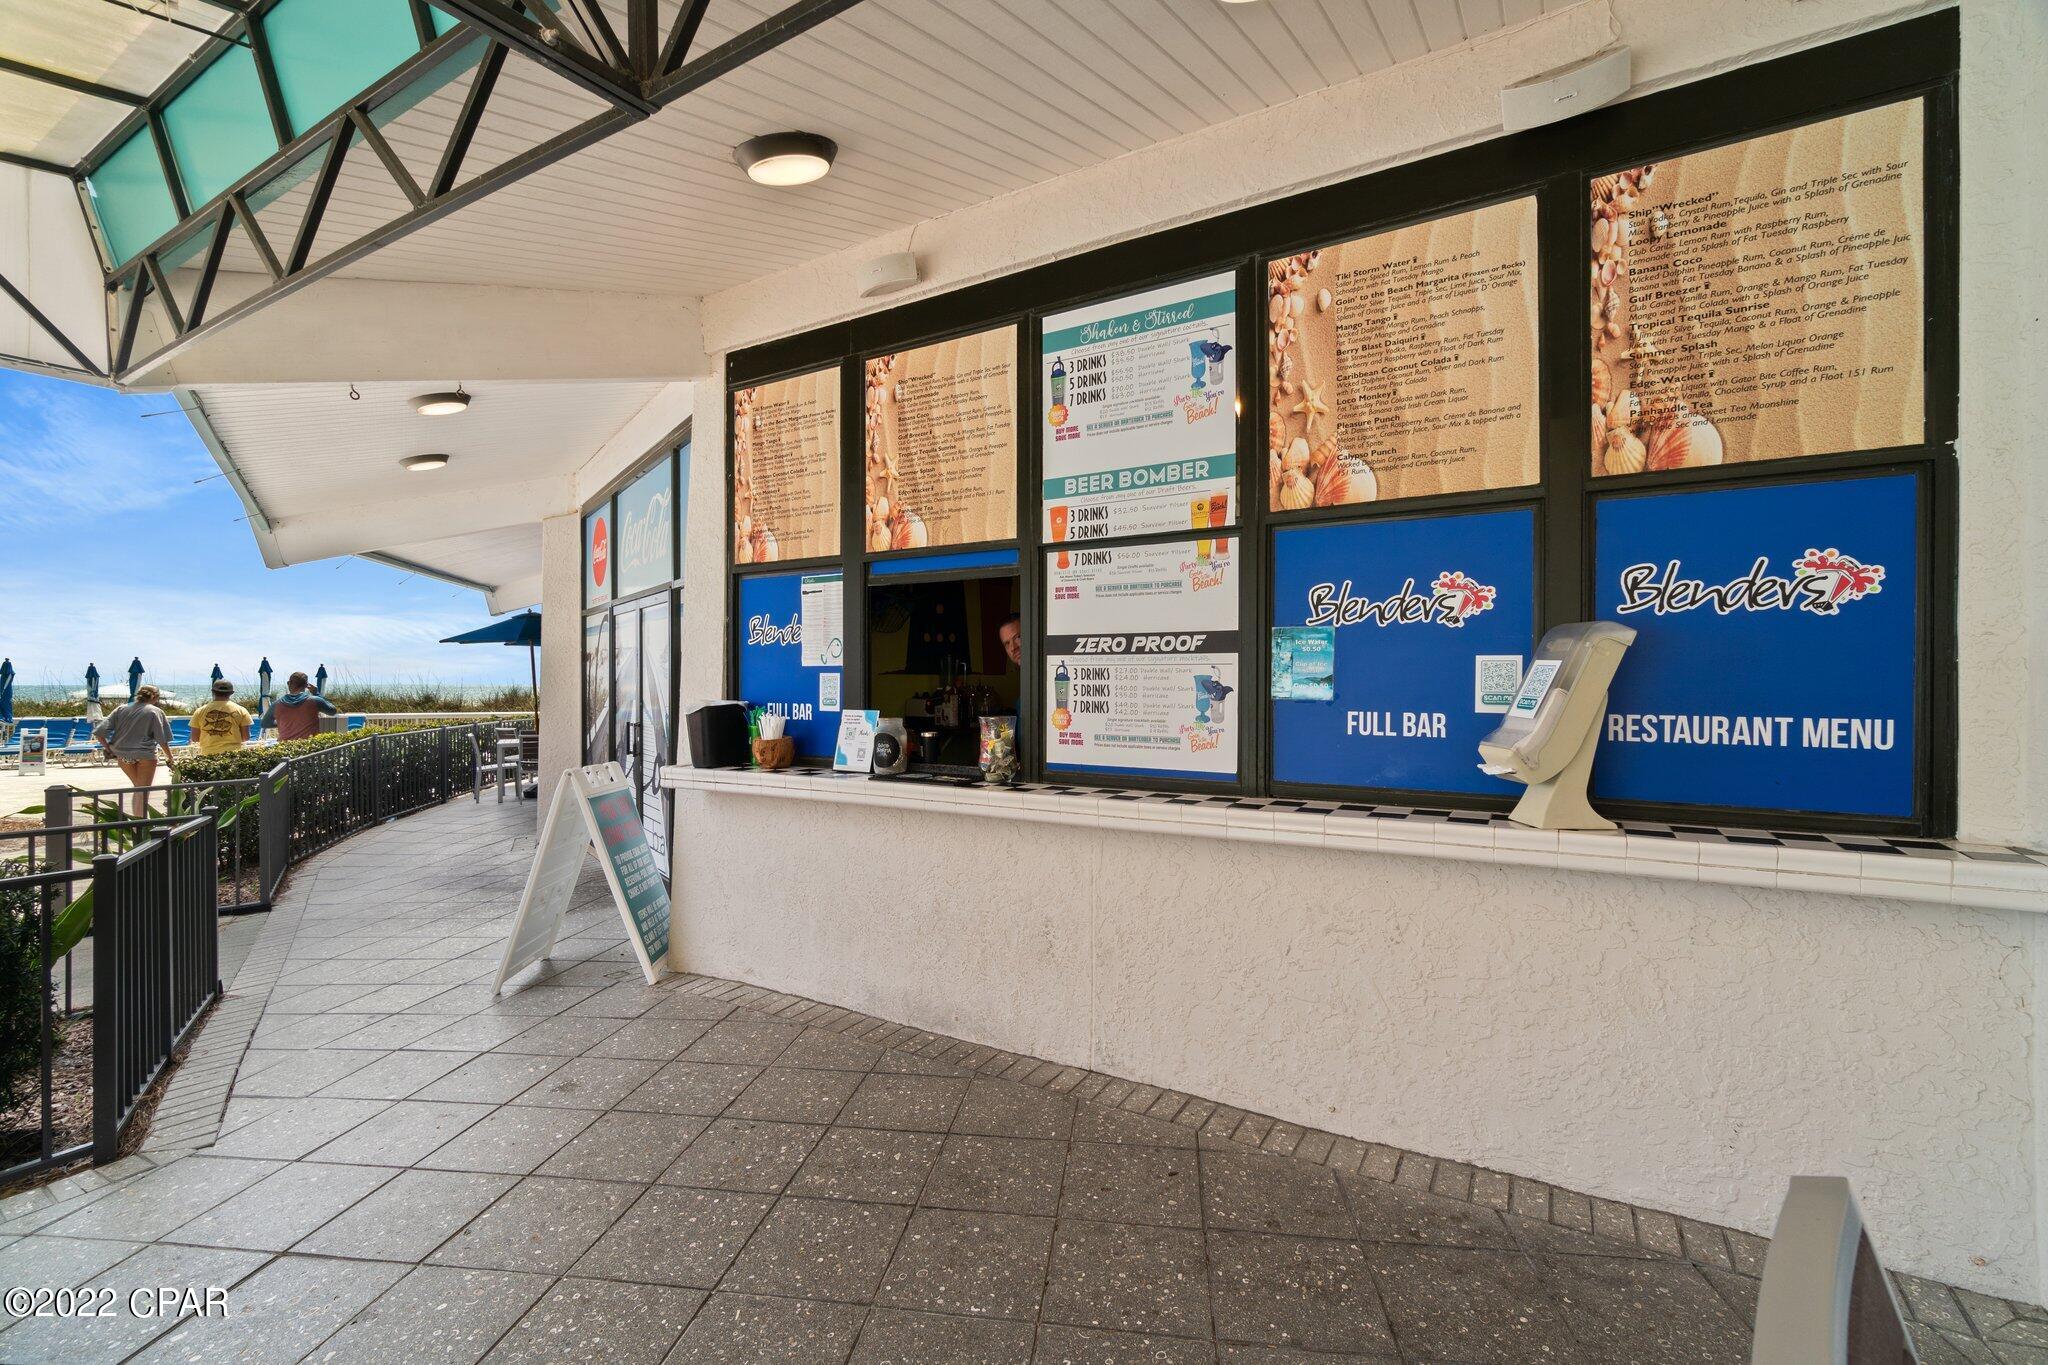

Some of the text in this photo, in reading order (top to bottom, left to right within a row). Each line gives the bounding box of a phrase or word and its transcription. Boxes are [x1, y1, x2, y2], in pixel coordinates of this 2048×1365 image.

[1679, 204, 1708, 218] Crystal
[1771, 187, 1785, 196] Gin
[1789, 182, 1806, 192] and
[1811, 175, 1837, 189] Triple
[1841, 171, 1857, 181] Sec
[1861, 166, 1881, 176] with
[1886, 160, 1908, 171] Sour
[1628, 220, 1726, 247] Loopy Lemonade
[1335, 258, 1410, 280] Tiki Storm Water
[1629, 255, 1702, 275] Banana Coco
[1371, 290, 1384, 298] the
[1387, 284, 1413, 294] Beach
[1416, 274, 1458, 290] Margarita
[1629, 284, 1701, 303] Gulf Breezer
[1629, 310, 1656, 322] Mango
[1660, 307, 1675, 315] and
[1699, 297, 1728, 308] Colada
[1732, 293, 1749, 302] with
[1763, 286, 1791, 298] Splash
[1795, 284, 1805, 293] of
[1808, 277, 1842, 290] Orange
[1845, 272, 1868, 284] Juice
[1080, 303, 1194, 343] Shaken & Stirred
[1336, 315, 1390, 332] Mango Tango
[1629, 301, 1769, 332] Tropical Tequila Sunrise
[1336, 334, 1418, 357] Berry Blast Daiquiri
[1629, 340, 1717, 359] Summer Splash
[1070, 355, 1106, 374] 3 DRINKS
[1336, 356, 1451, 381] Caribbean Coconut Colada
[1070, 371, 1107, 390] 5 DRINKS
[1630, 371, 1705, 389] Edge-Wacker
[1645, 394, 1678, 405] Tuesday
[1681, 389, 1711, 400] Vanilla,
[1714, 383, 1757, 395] Chocolate
[1761, 379, 1786, 390] Syrup
[1790, 376, 1807, 384] and
[1820, 372, 1842, 381] Float
[1871, 365, 1893, 374] Rum
[1070, 389, 1106, 406] 7 DRINKS
[1336, 391, 1391, 405] Loco Monkey
[1630, 400, 1712, 416] Panhandle Tea
[1337, 414, 1399, 429] Pleasure Punch
[1337, 447, 1396, 462] Calypso Punch
[1064, 461, 1210, 495] BEER BOMBER
[1070, 510, 1075, 522] 3
[1078, 506, 1108, 521] DRINKS
[1070, 527, 1075, 539] 5
[1078, 523, 1108, 539] DRINKS
[1074, 553, 1078, 566] 7
[1080, 551, 1112, 566] DRINKS
[1192, 568, 1224, 592] Beach!
[1616, 556, 1830, 616] Blenders
[1305, 577, 1459, 628] Blenders
[748, 613, 802, 647] Blende
[1074, 635, 1207, 653] ZERO PROOF
[1074, 668, 1078, 680] 3
[1081, 668, 1110, 680] DRINKS
[1074, 685, 1078, 696] 5
[1081, 684, 1110, 697] DRINKS
[792, 703, 812, 720] BAR
[1073, 701, 1077, 713] 7
[1080, 701, 1109, 713] DRINKS
[1347, 710, 1446, 738] FULL BAR
[1608, 713, 1895, 750] RESTAURANT MENU
